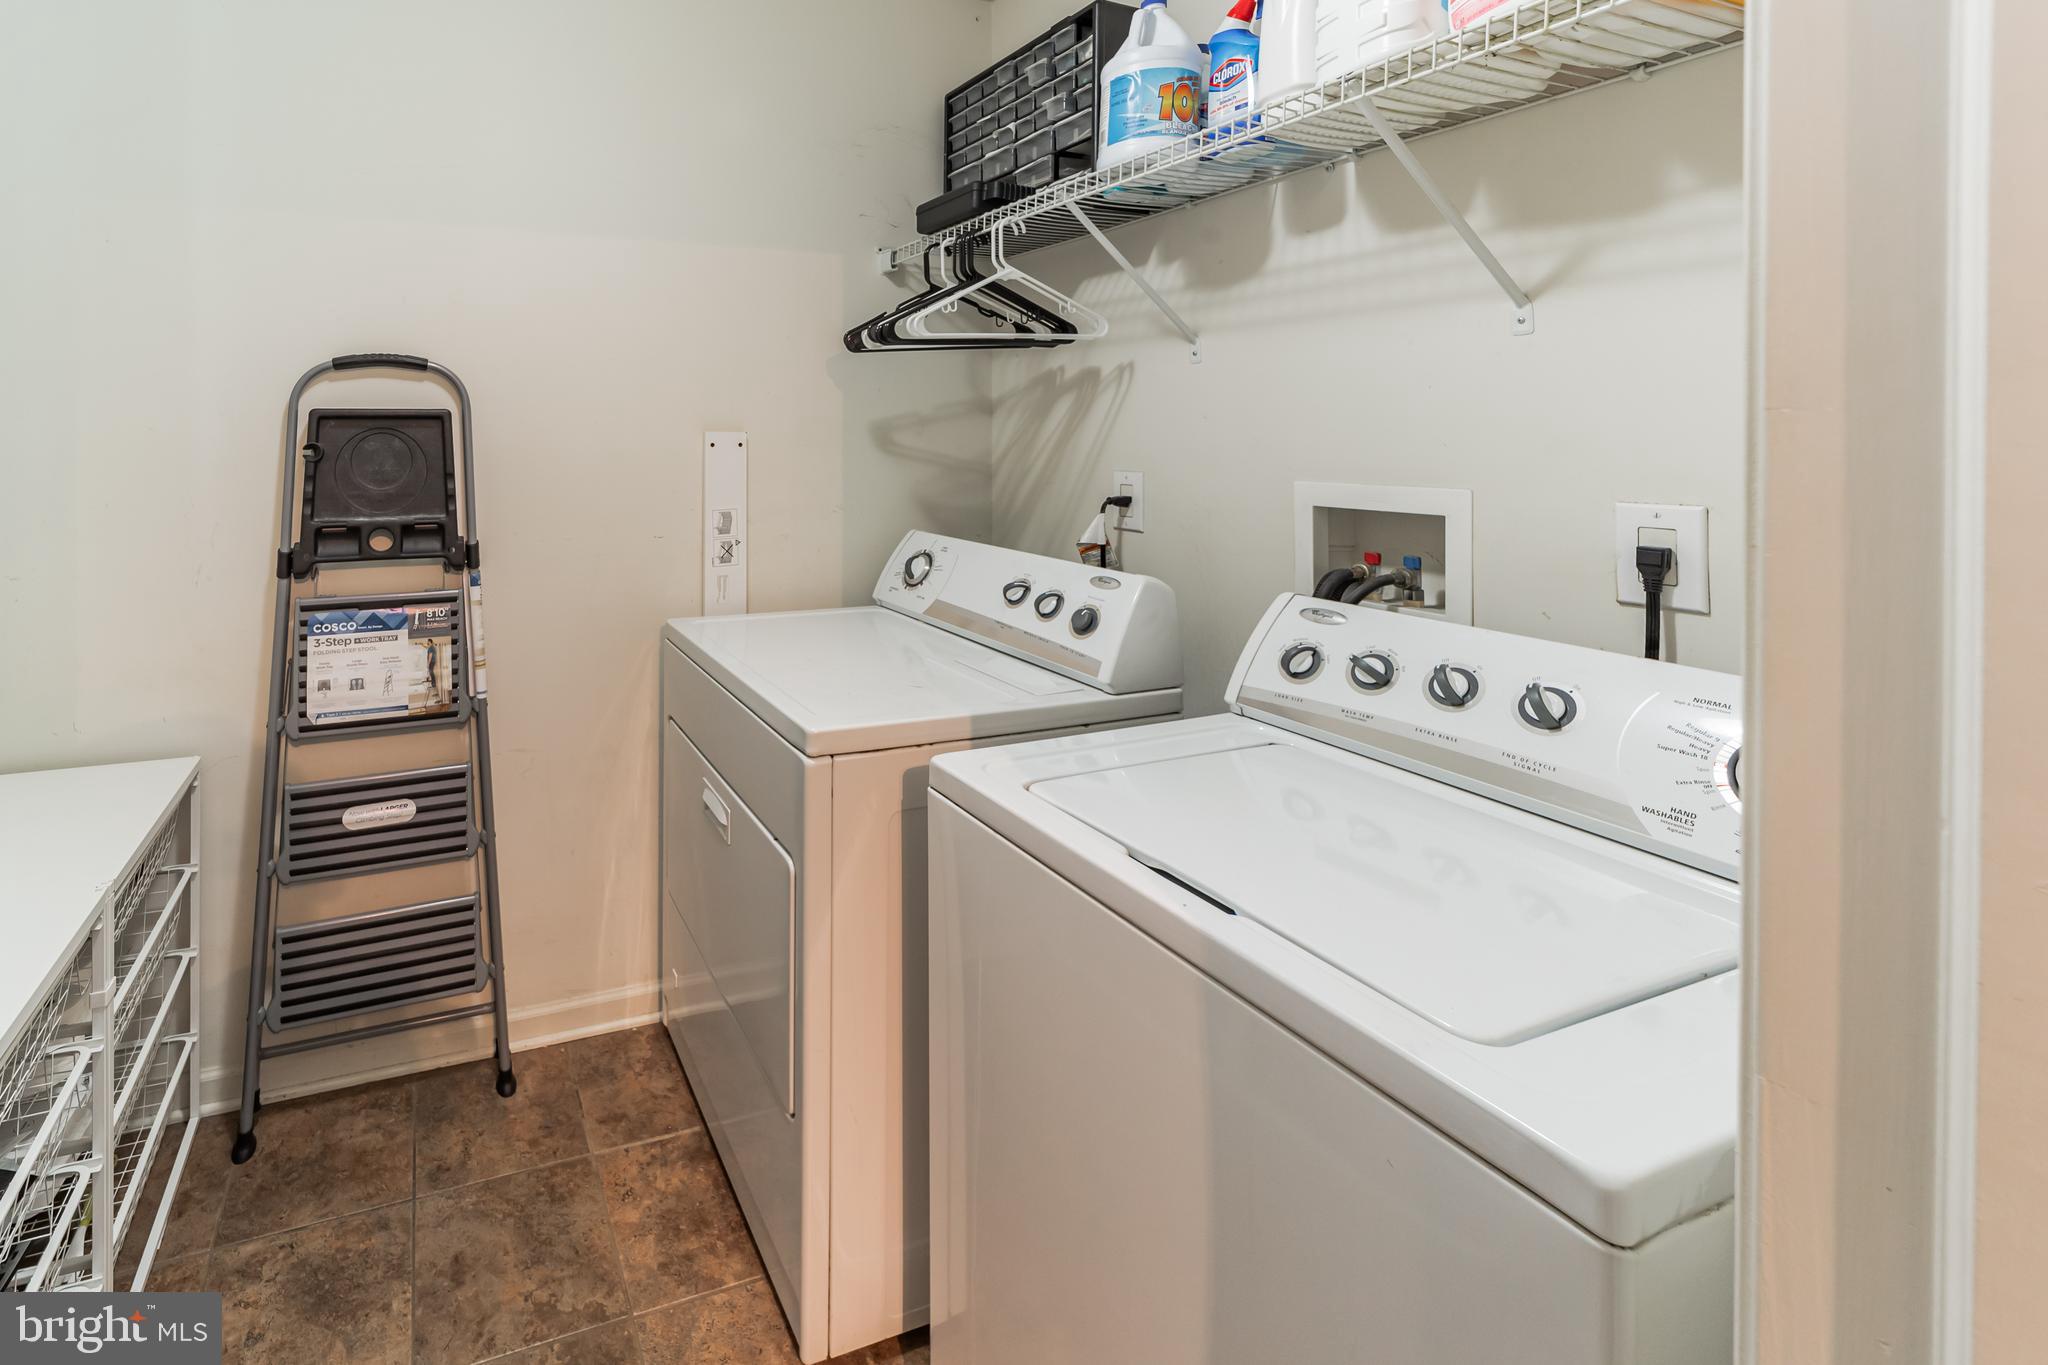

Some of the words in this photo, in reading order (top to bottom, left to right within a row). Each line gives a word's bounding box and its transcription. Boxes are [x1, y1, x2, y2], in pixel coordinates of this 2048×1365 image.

[1213, 61, 1247, 84] CLOROX
[313, 621, 357, 633] COSCO
[313, 637, 352, 648] 3-Step
[1693, 697, 1732, 709] NORMAL
[1359, 712, 1375, 720] TEMP
[1415, 727, 1436, 737] EXTRA
[1438, 733, 1458, 743] RINSE
[1667, 725, 1715, 748] Regular/Heavy
[1685, 722, 1713, 739] Regular
[1656, 743, 1677, 753] Super
[1679, 749, 1698, 758] Wash
[1688, 743, 1711, 754] Heavy
[1502, 752, 1516, 760] END
[1533, 761, 1557, 772] CYCLE
[1513, 762, 1541, 774] SIGNAL
[1641, 805, 1695, 827] WASHABLES
[1670, 807, 1697, 819] HAND
